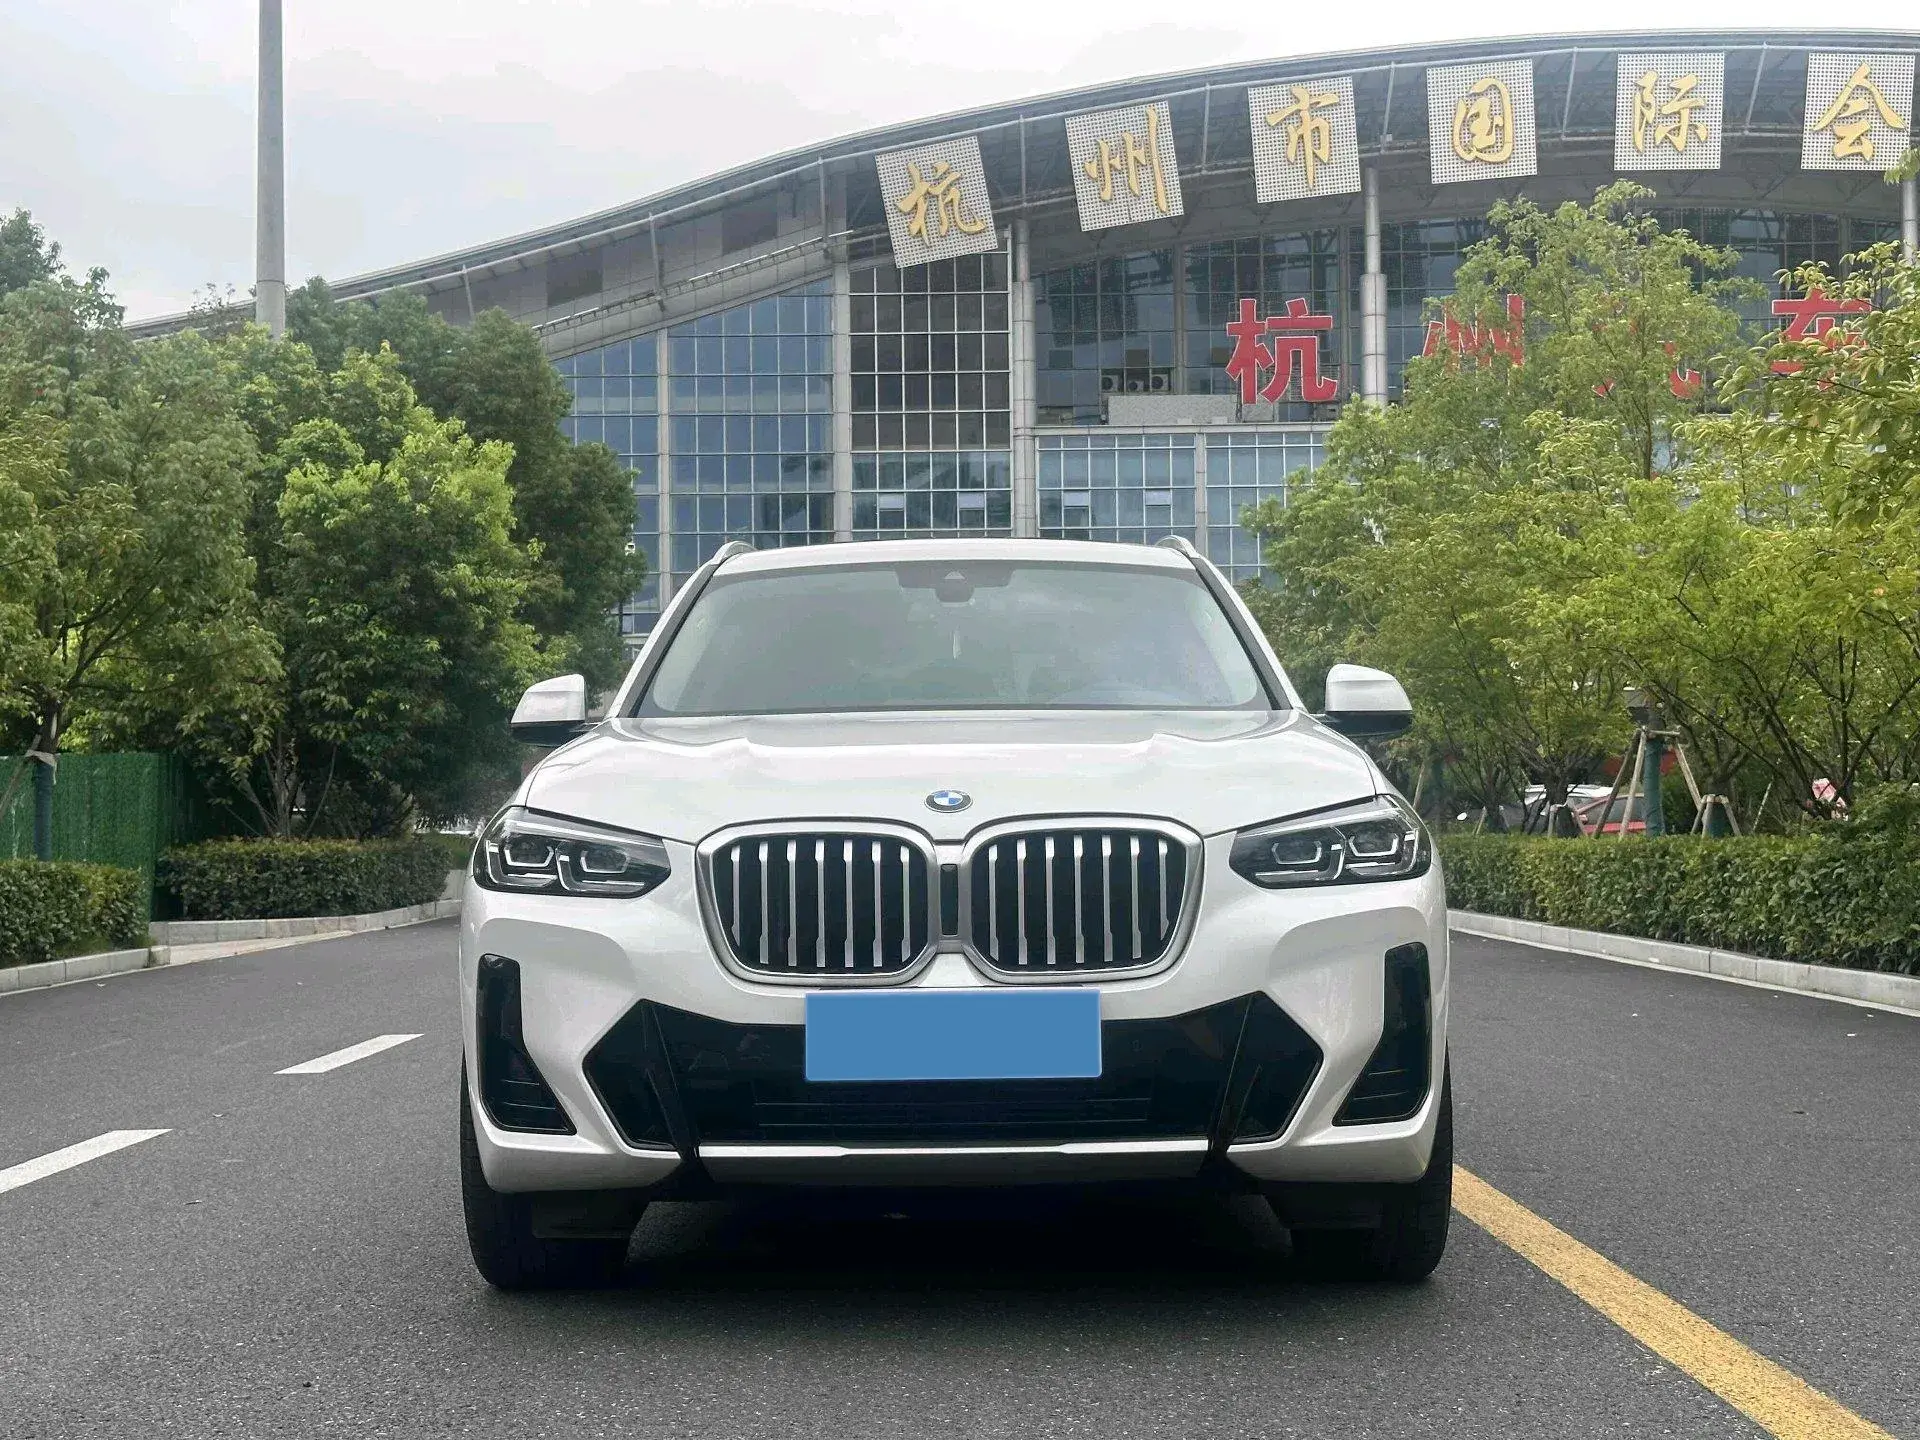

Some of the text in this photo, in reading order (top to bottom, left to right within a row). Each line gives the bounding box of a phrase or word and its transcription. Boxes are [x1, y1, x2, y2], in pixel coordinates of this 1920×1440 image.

[896, 61, 1907, 247] 杭州市国际会
